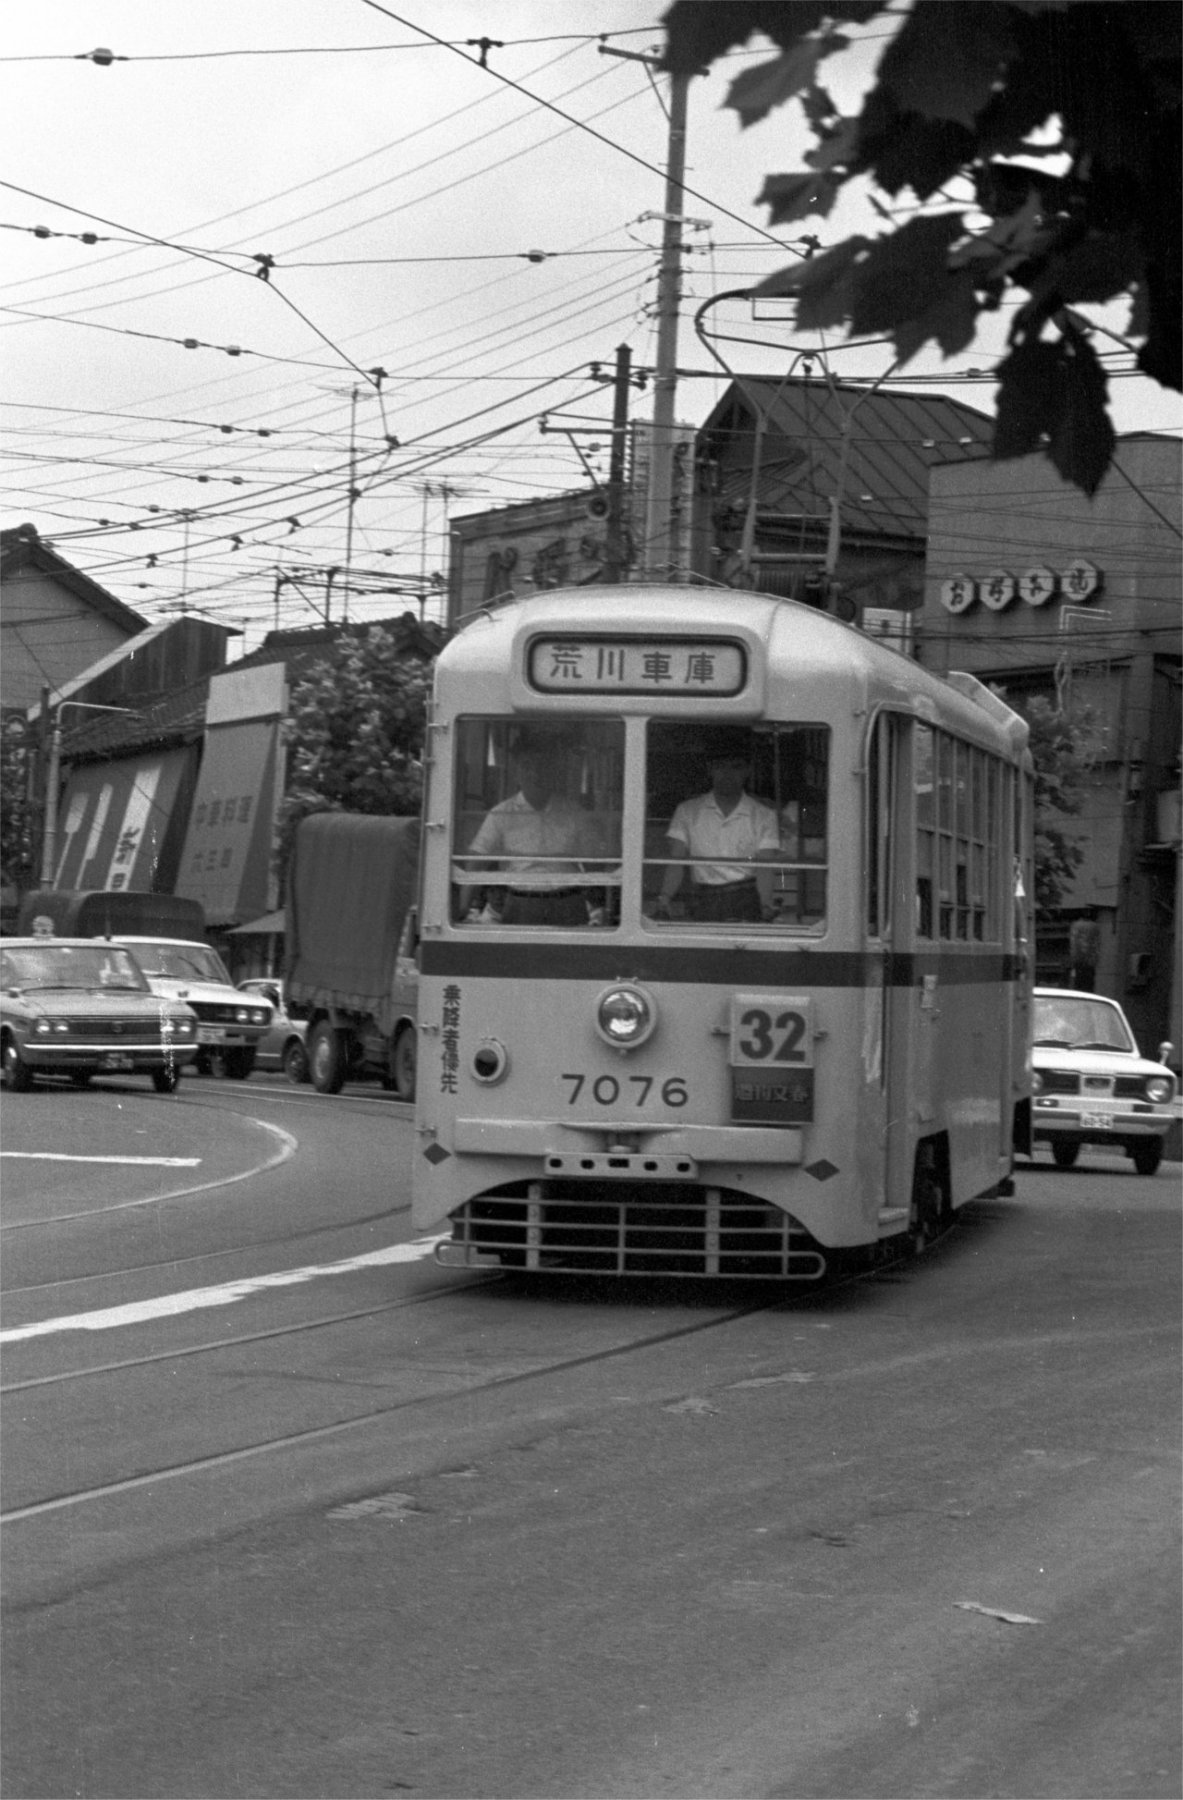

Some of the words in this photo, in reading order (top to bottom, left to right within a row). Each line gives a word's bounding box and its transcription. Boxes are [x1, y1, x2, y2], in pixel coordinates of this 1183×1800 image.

[550, 645, 716, 684] 荒川車庫
[440, 984, 462, 1094] 乗降者優先
[739, 1009, 807, 1062] 32
[561, 1073, 689, 1108] 7076
[735, 1083, 809, 1102] 週刊文春
